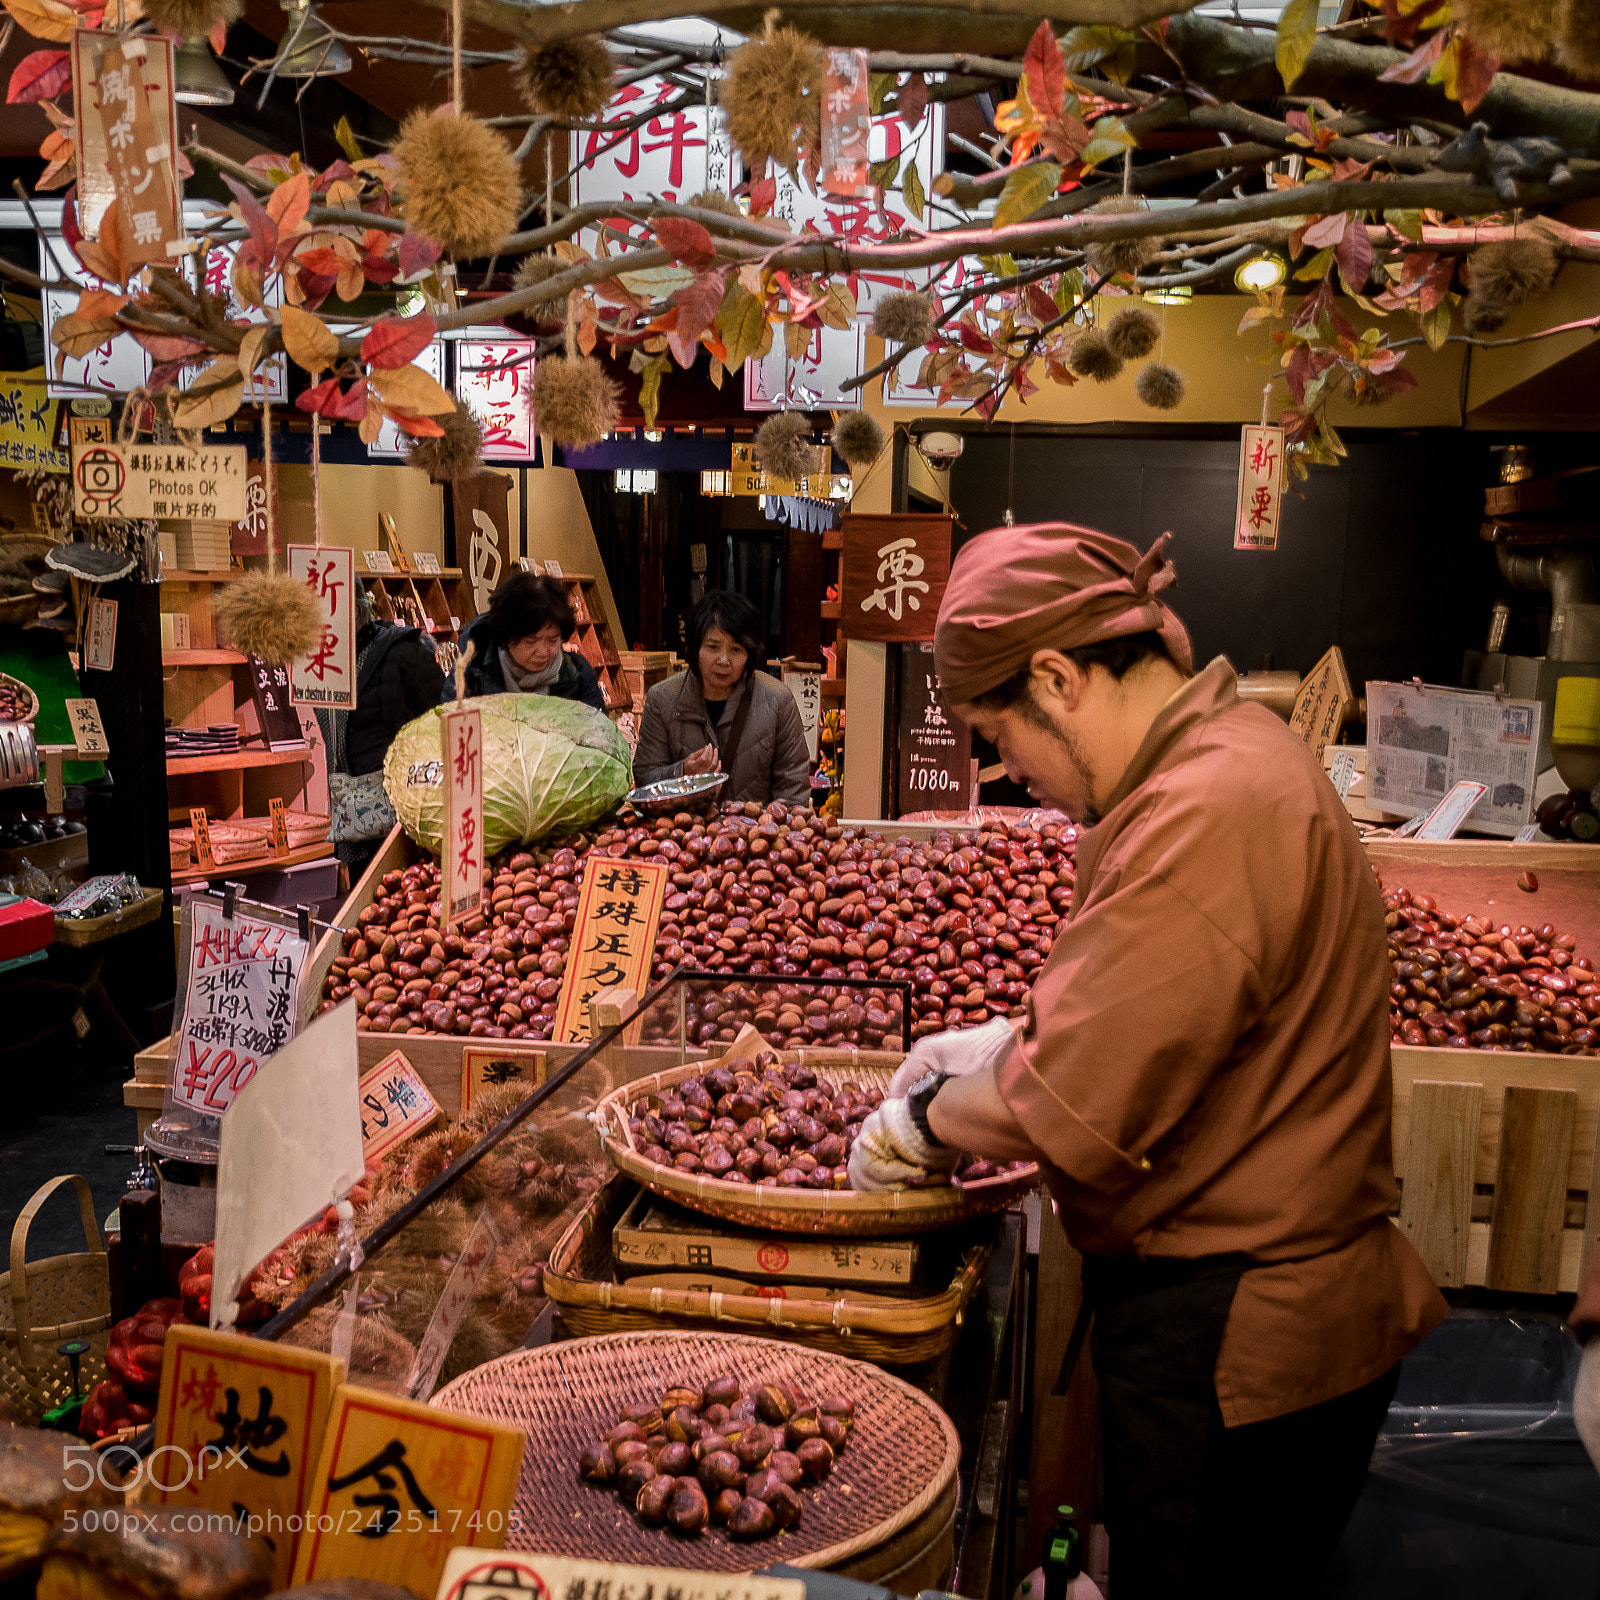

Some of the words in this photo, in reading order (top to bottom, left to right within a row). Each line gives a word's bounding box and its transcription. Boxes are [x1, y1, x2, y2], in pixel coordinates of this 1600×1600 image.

[81, 497, 123, 517] OK
[150, 479, 194, 497] Photos
[199, 480, 217, 496] OK
[153, 501, 216, 518] 照片好的
[1249, 437, 1277, 529] 新栗
[304, 559, 345, 682] 新栗
[860, 537, 929, 621] 栗
[293, 684, 304, 700] New
[304, 684, 326, 701] chestnut
[454, 725, 477, 883] 新栗
[327, 1438, 439, 1539] 今
